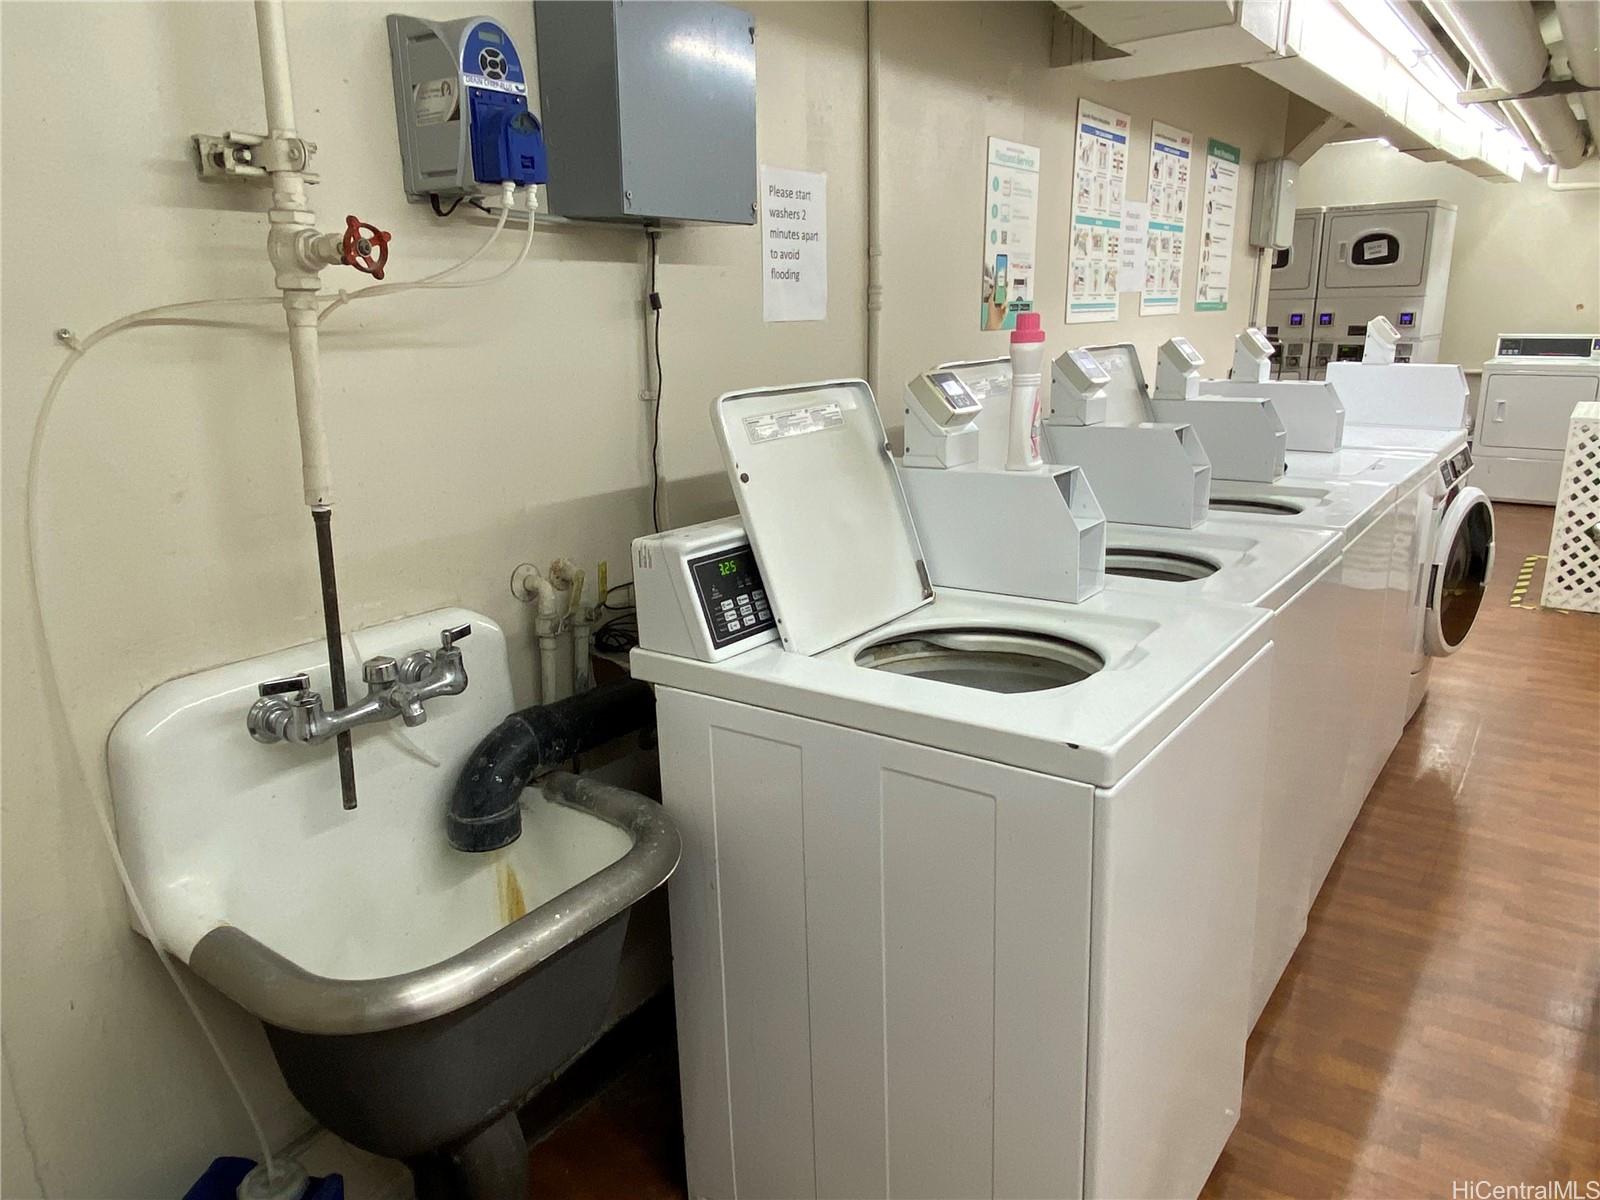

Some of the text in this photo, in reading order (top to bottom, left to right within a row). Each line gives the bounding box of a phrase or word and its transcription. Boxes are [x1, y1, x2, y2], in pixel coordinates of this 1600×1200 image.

[769, 184, 811, 201] Please start
[769, 208, 807, 221] washers 2
[769, 228, 819, 243] minutes apart
[770, 249, 800, 261] to avoid
[771, 267, 800, 282] flooding
